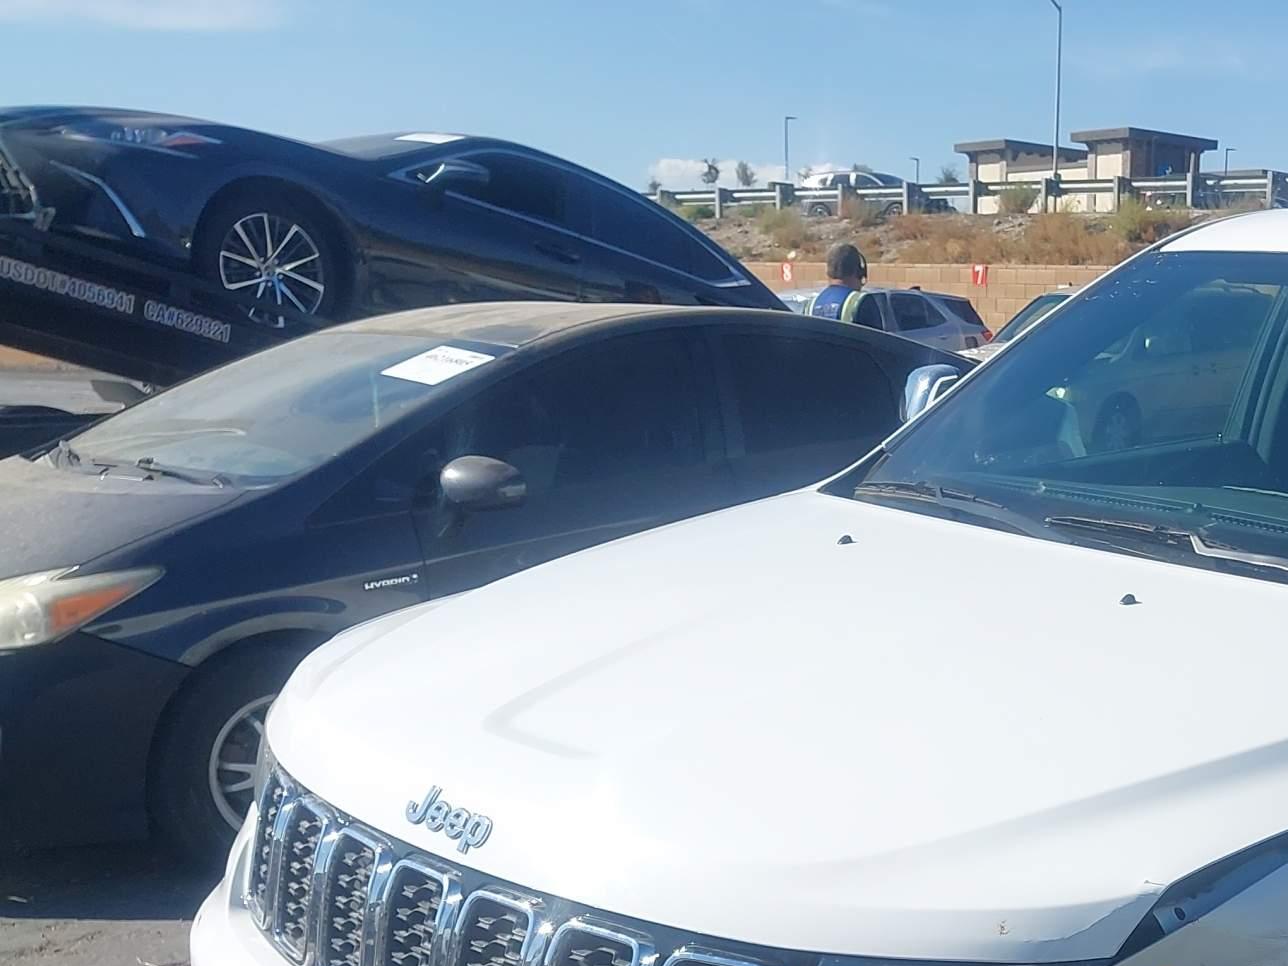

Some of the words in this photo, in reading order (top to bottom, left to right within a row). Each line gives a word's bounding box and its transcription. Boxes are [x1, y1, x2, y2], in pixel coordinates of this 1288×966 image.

[783, 263, 792, 281] 8
[975, 265, 983, 284] 7
[405, 785, 493, 855] Jeep
